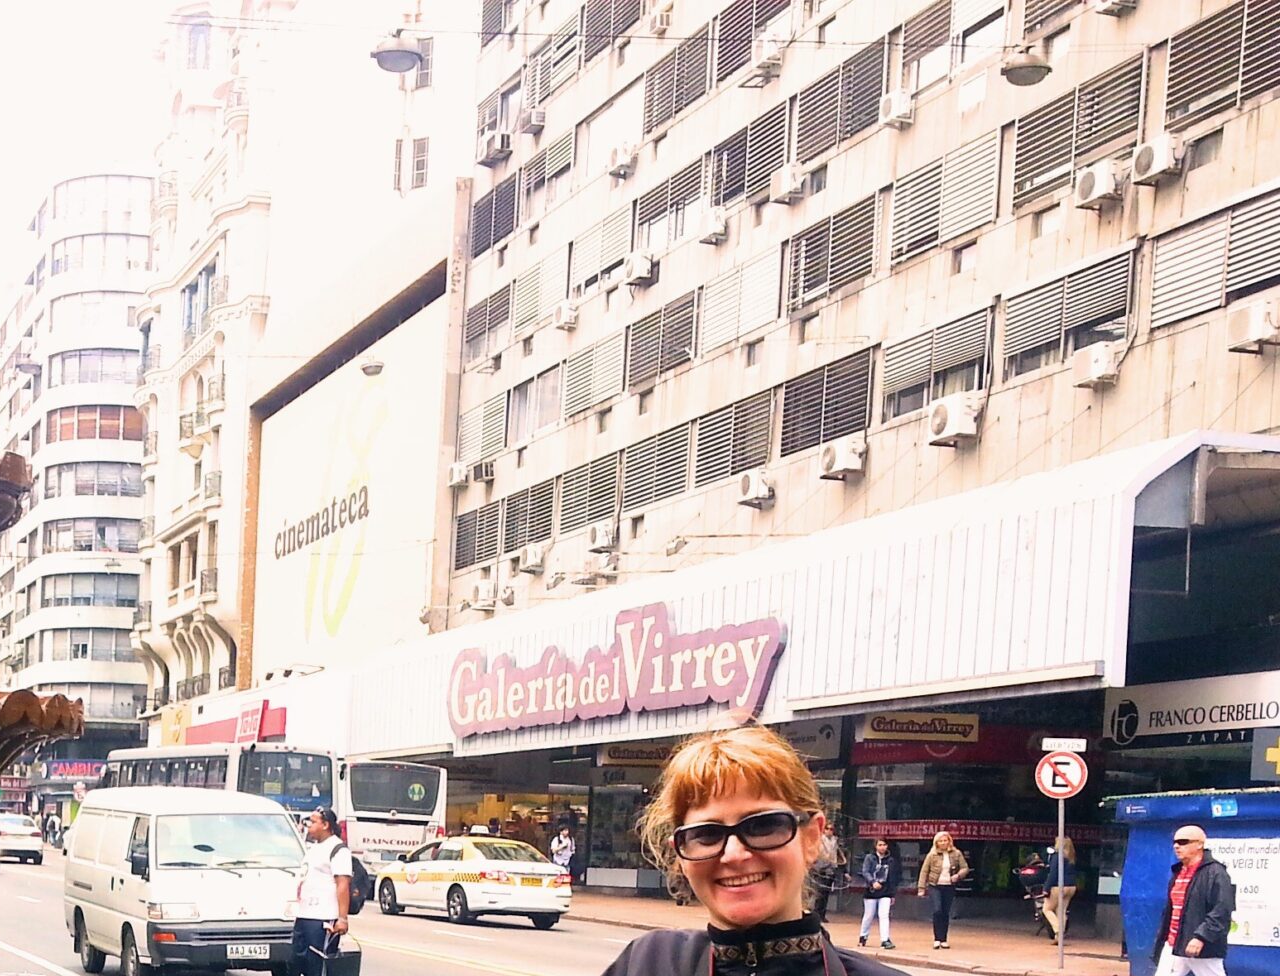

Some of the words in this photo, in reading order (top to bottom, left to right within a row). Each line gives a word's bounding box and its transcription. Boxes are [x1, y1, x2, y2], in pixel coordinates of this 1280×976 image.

[274, 485, 370, 560] cinemateca
[452, 652, 577, 726] Galería
[579, 655, 620, 705] del
[616, 616, 769, 706] Virrey
[1149, 706, 1205, 728] FRANCO
[1209, 700, 1280, 724] CERBELLO
[1256, 858, 1269, 869] LTE
